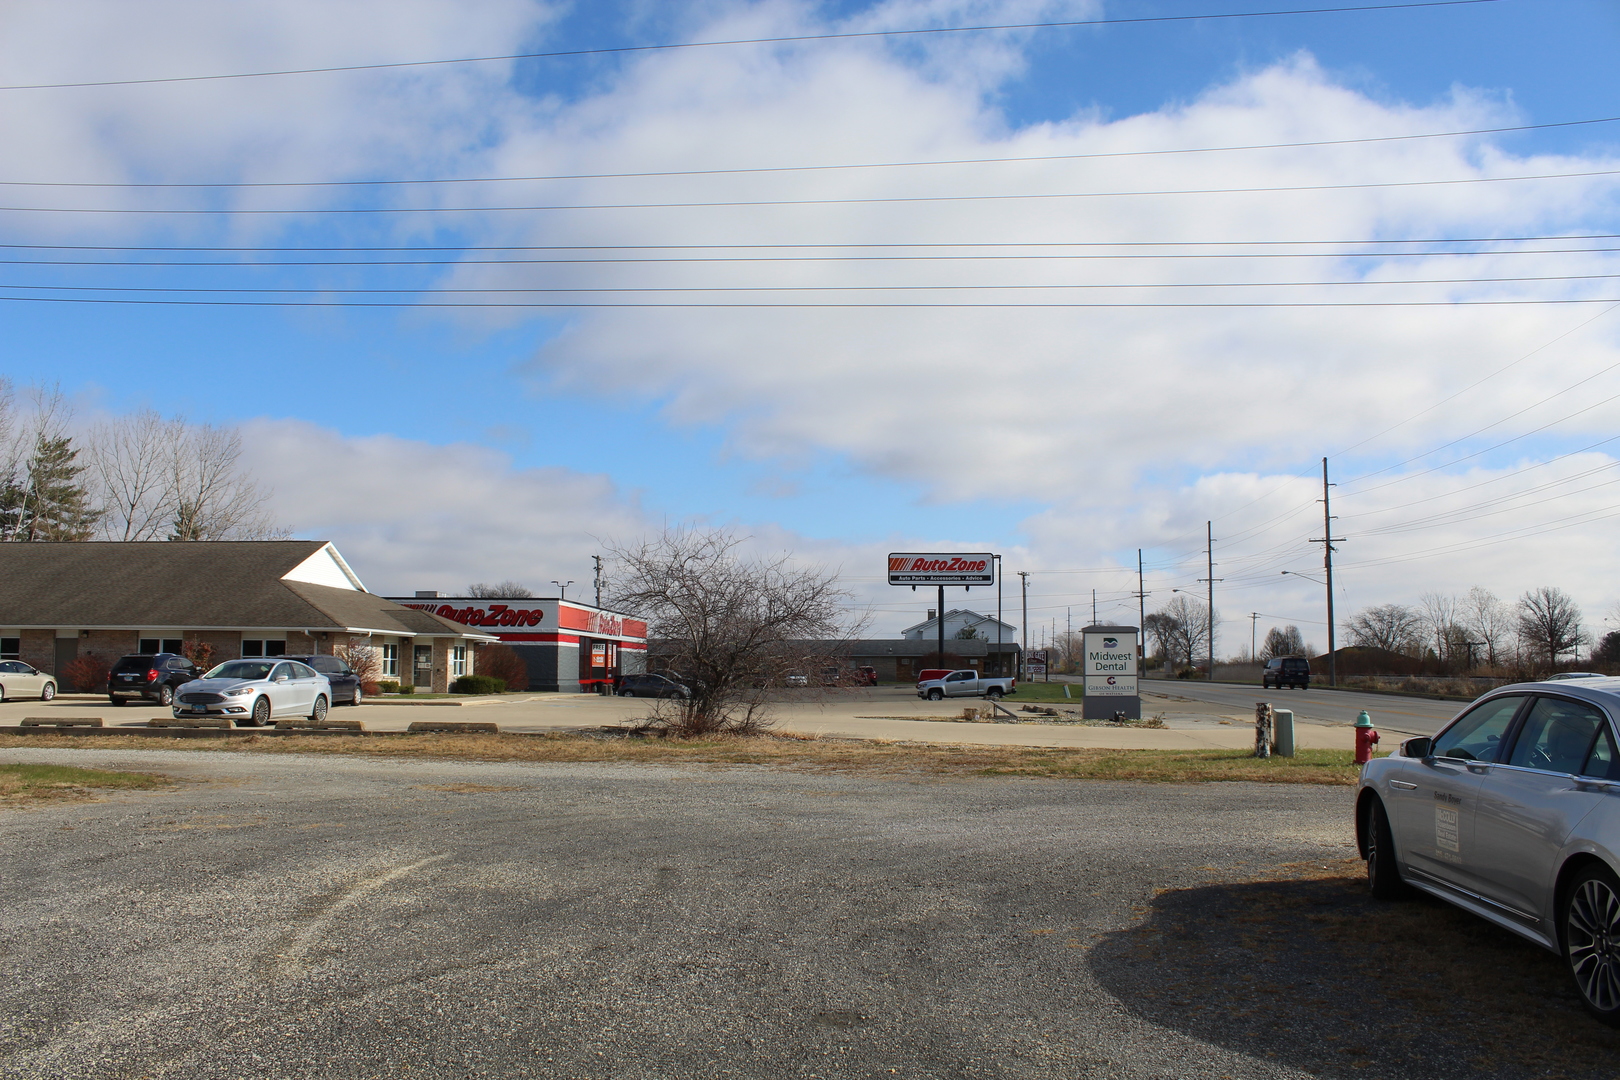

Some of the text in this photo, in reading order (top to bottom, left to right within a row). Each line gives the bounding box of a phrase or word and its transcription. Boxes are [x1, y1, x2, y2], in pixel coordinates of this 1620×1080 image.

[911, 558, 987, 573] AutoZone
[1089, 652, 1132, 661] Midwest
[1095, 662, 1127, 671] Dental
